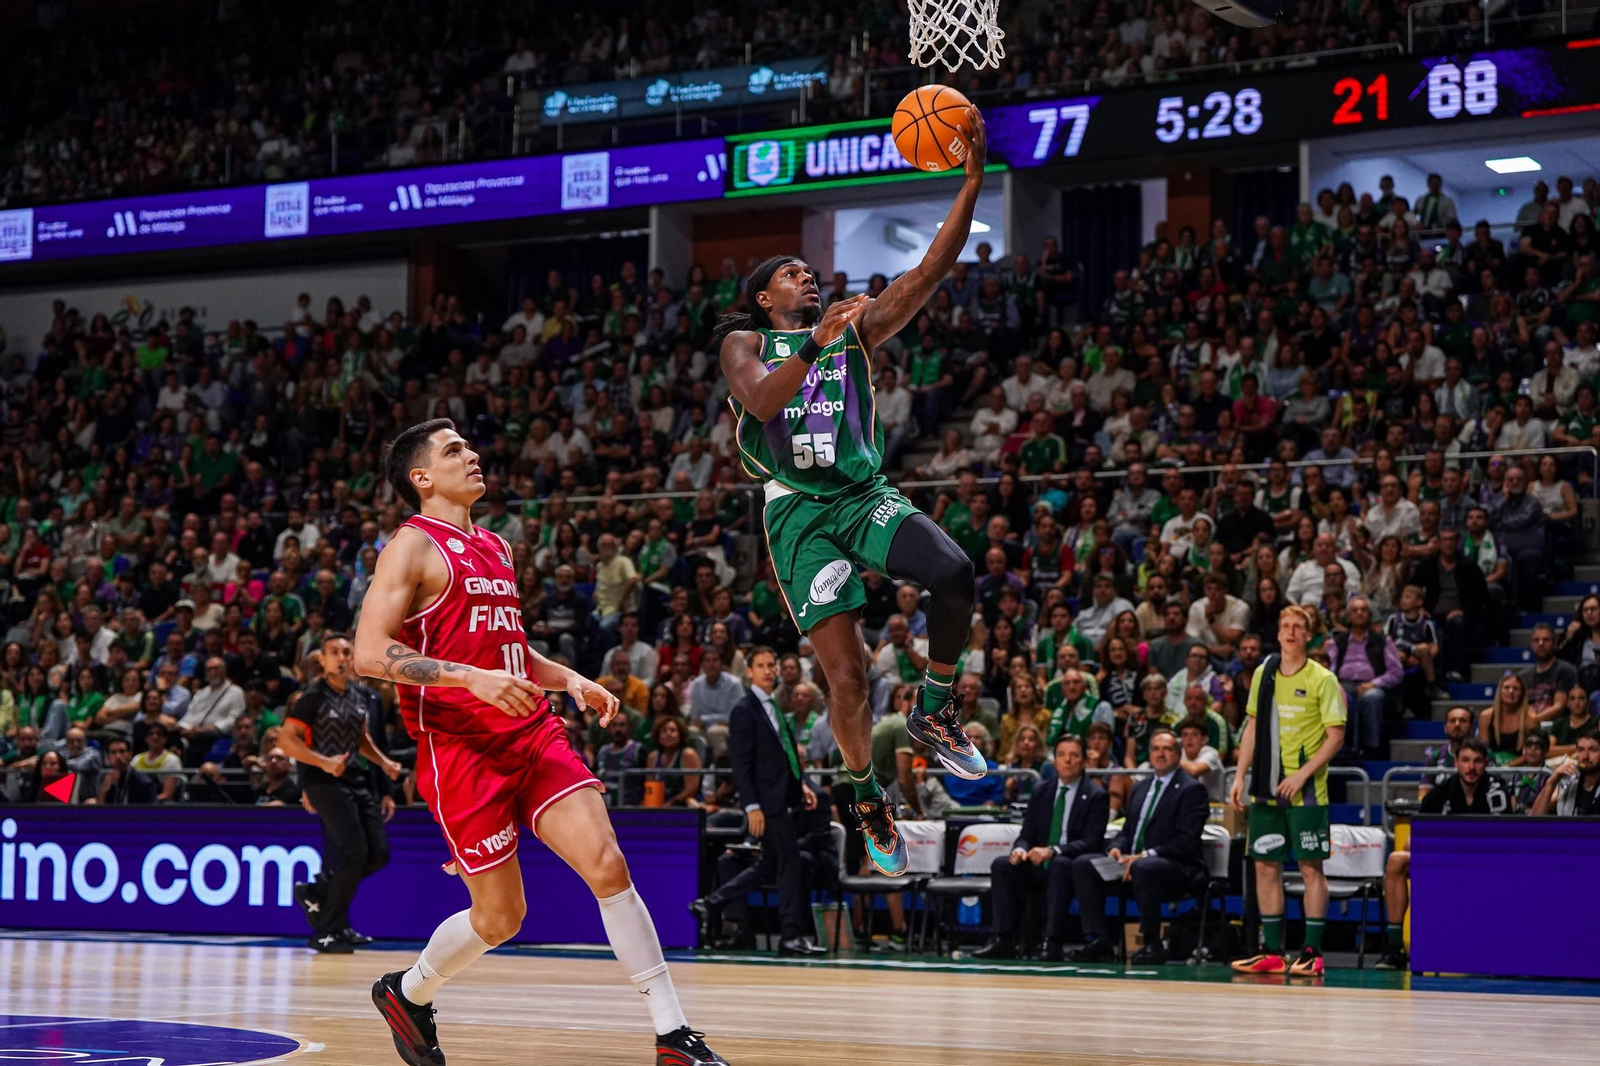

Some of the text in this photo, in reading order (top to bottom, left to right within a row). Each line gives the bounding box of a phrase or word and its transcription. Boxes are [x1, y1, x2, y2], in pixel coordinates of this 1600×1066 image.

[1331, 74, 1389, 125] 21
[1427, 59, 1498, 119] 68
[1028, 104, 1090, 160] 77
[1155, 88, 1263, 143] 5:28
[805, 132, 914, 177] UNICA
[791, 432, 836, 470] 55
[501, 642, 527, 679] 10
